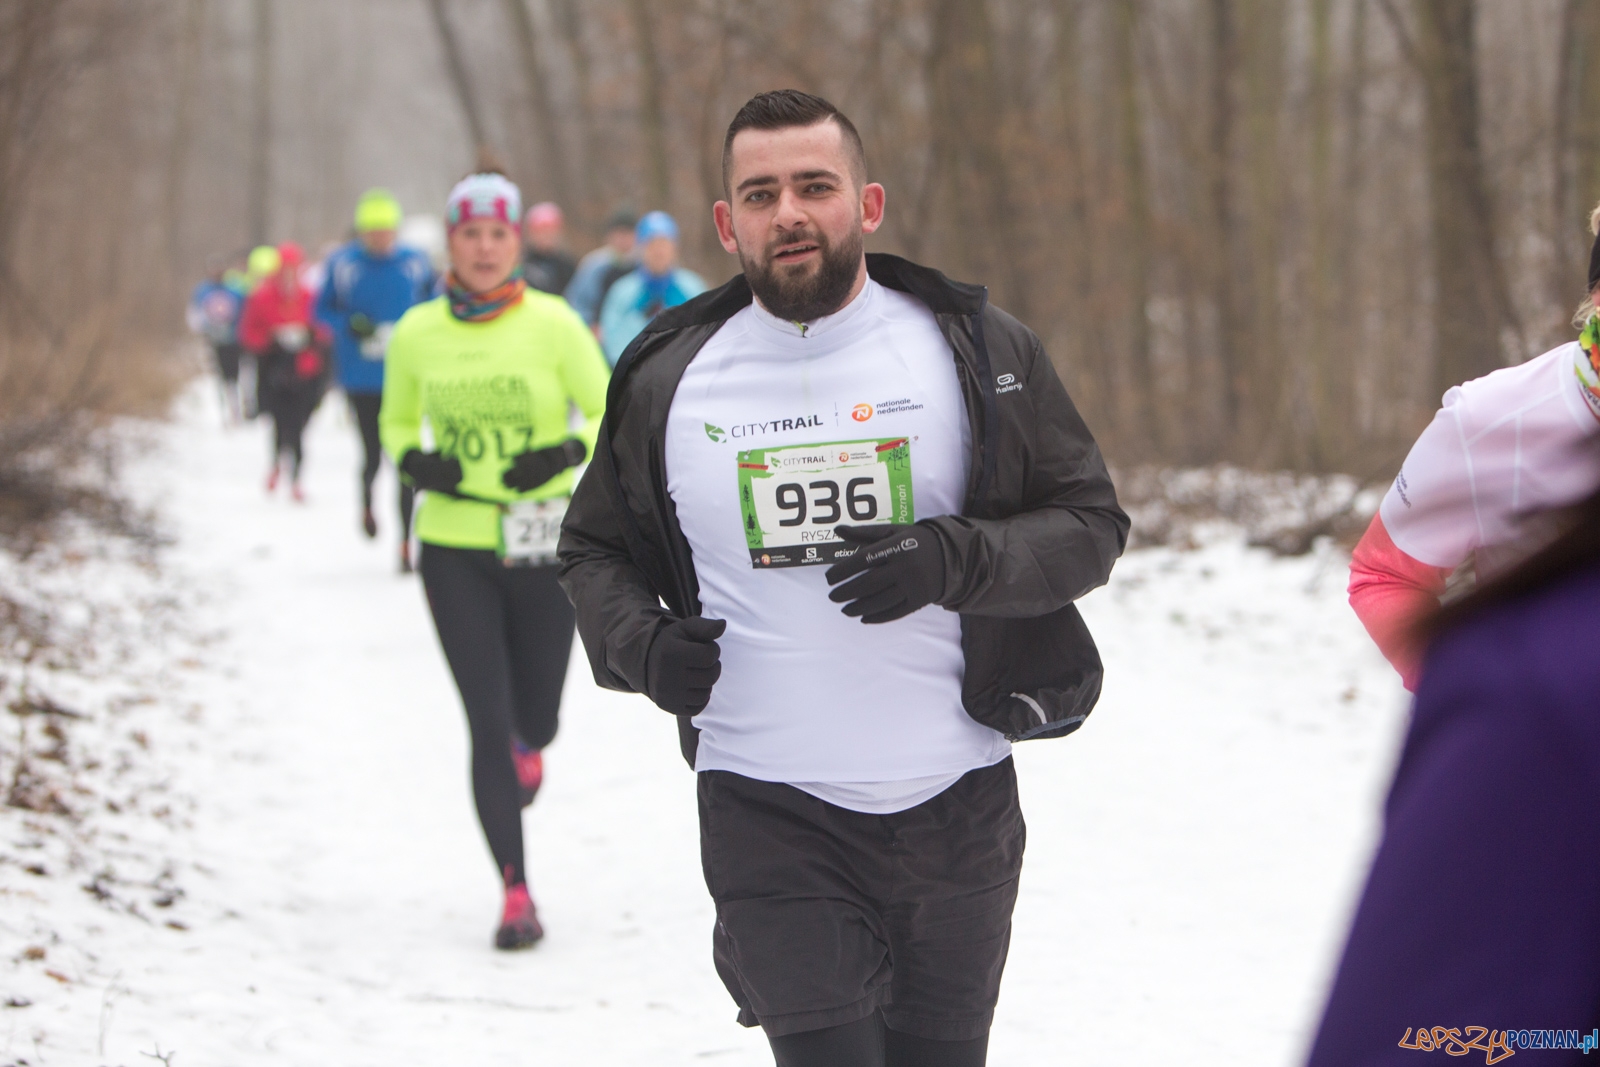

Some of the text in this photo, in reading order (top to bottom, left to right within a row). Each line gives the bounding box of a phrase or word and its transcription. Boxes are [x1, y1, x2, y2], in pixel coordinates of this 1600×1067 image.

[876, 399, 911, 409] nationale
[877, 404, 924, 415] nederlanden
[776, 477, 878, 527] 936
[898, 484, 906, 523] Poznań
